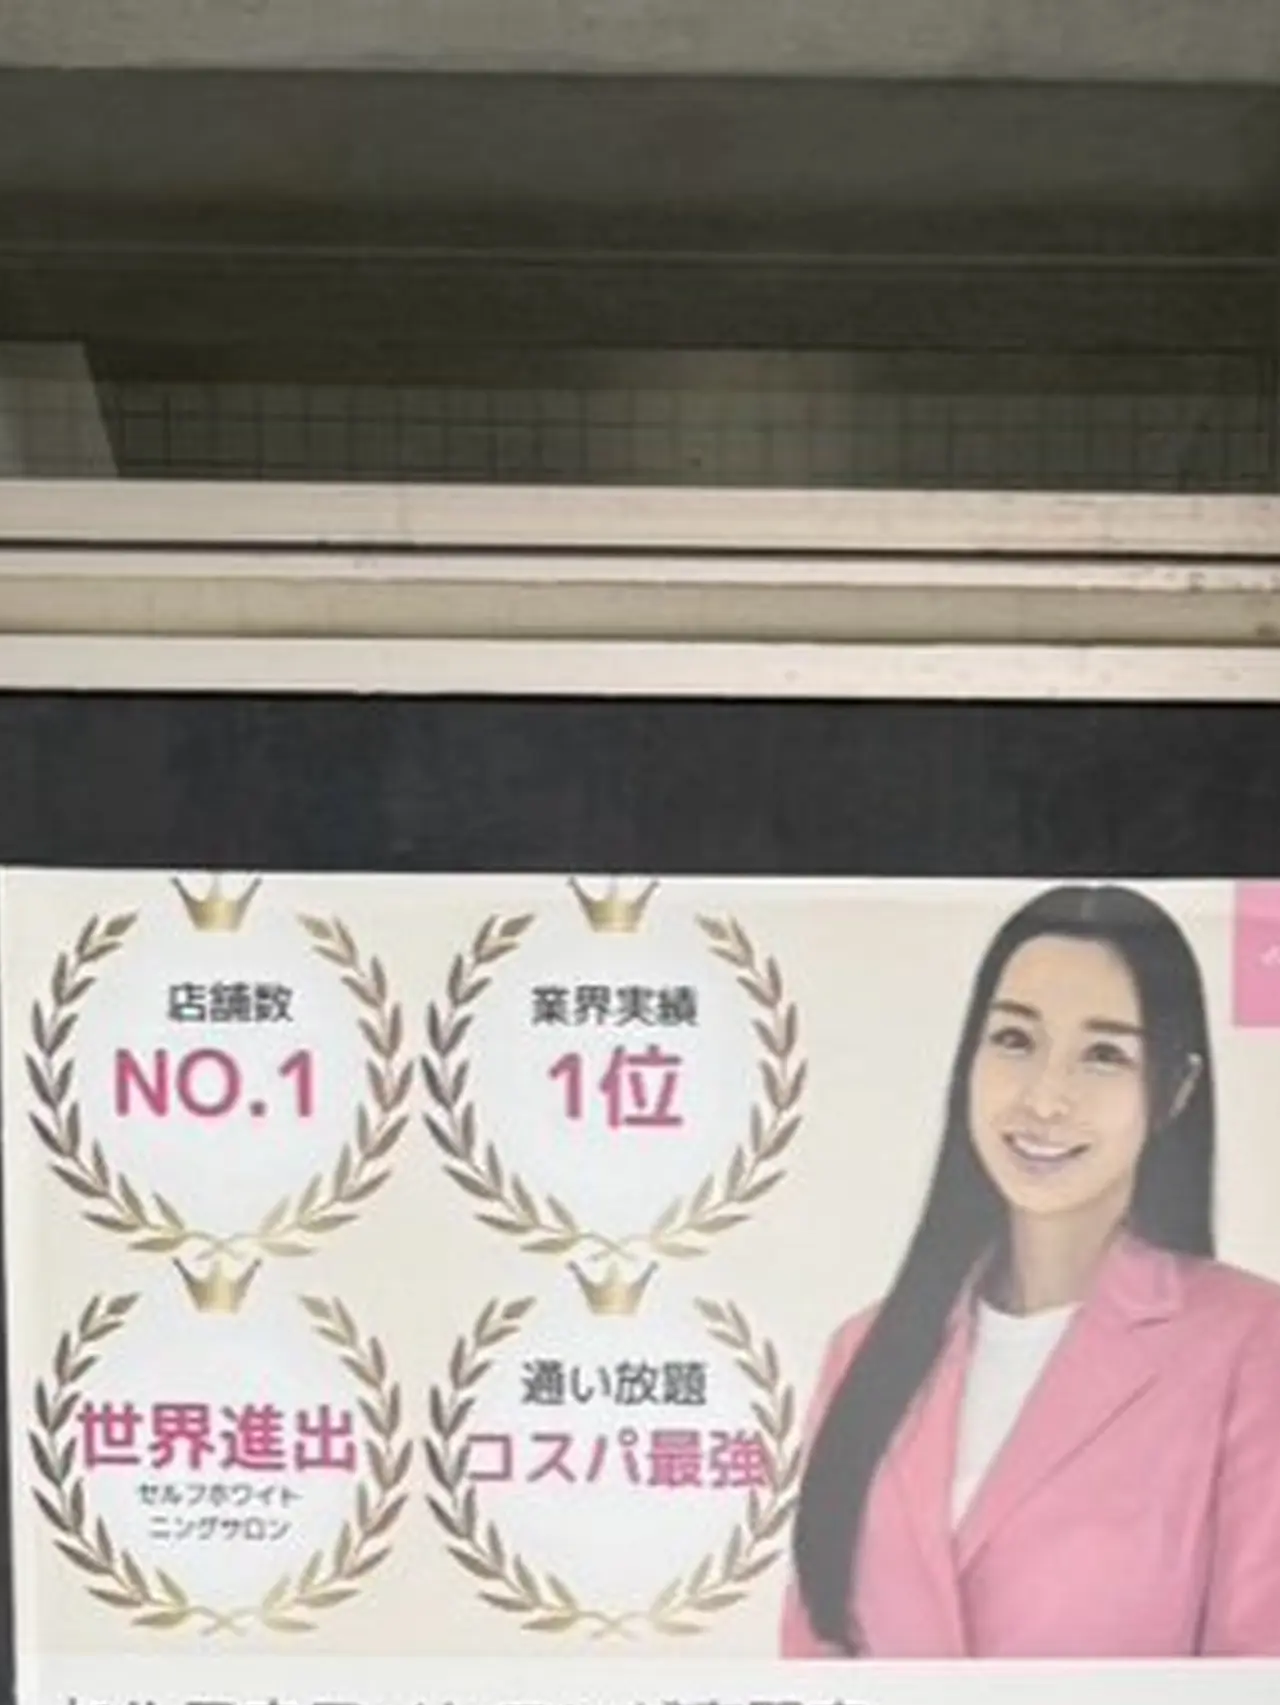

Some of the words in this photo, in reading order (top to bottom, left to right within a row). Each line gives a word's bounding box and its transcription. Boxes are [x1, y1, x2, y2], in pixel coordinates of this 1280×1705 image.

[166, 981, 294, 1024] 店舗数
[531, 984, 699, 1027] 業界実績
[114, 1048, 316, 1118] NO.1
[547, 1043, 684, 1130] 1位
[521, 1359, 707, 1407] 通い放題
[76, 1402, 358, 1474] 世界進出
[466, 1428, 768, 1490] コスパ最強
[138, 1483, 302, 1508] セルフホワイト
[149, 1515, 291, 1542] ニングサロン
